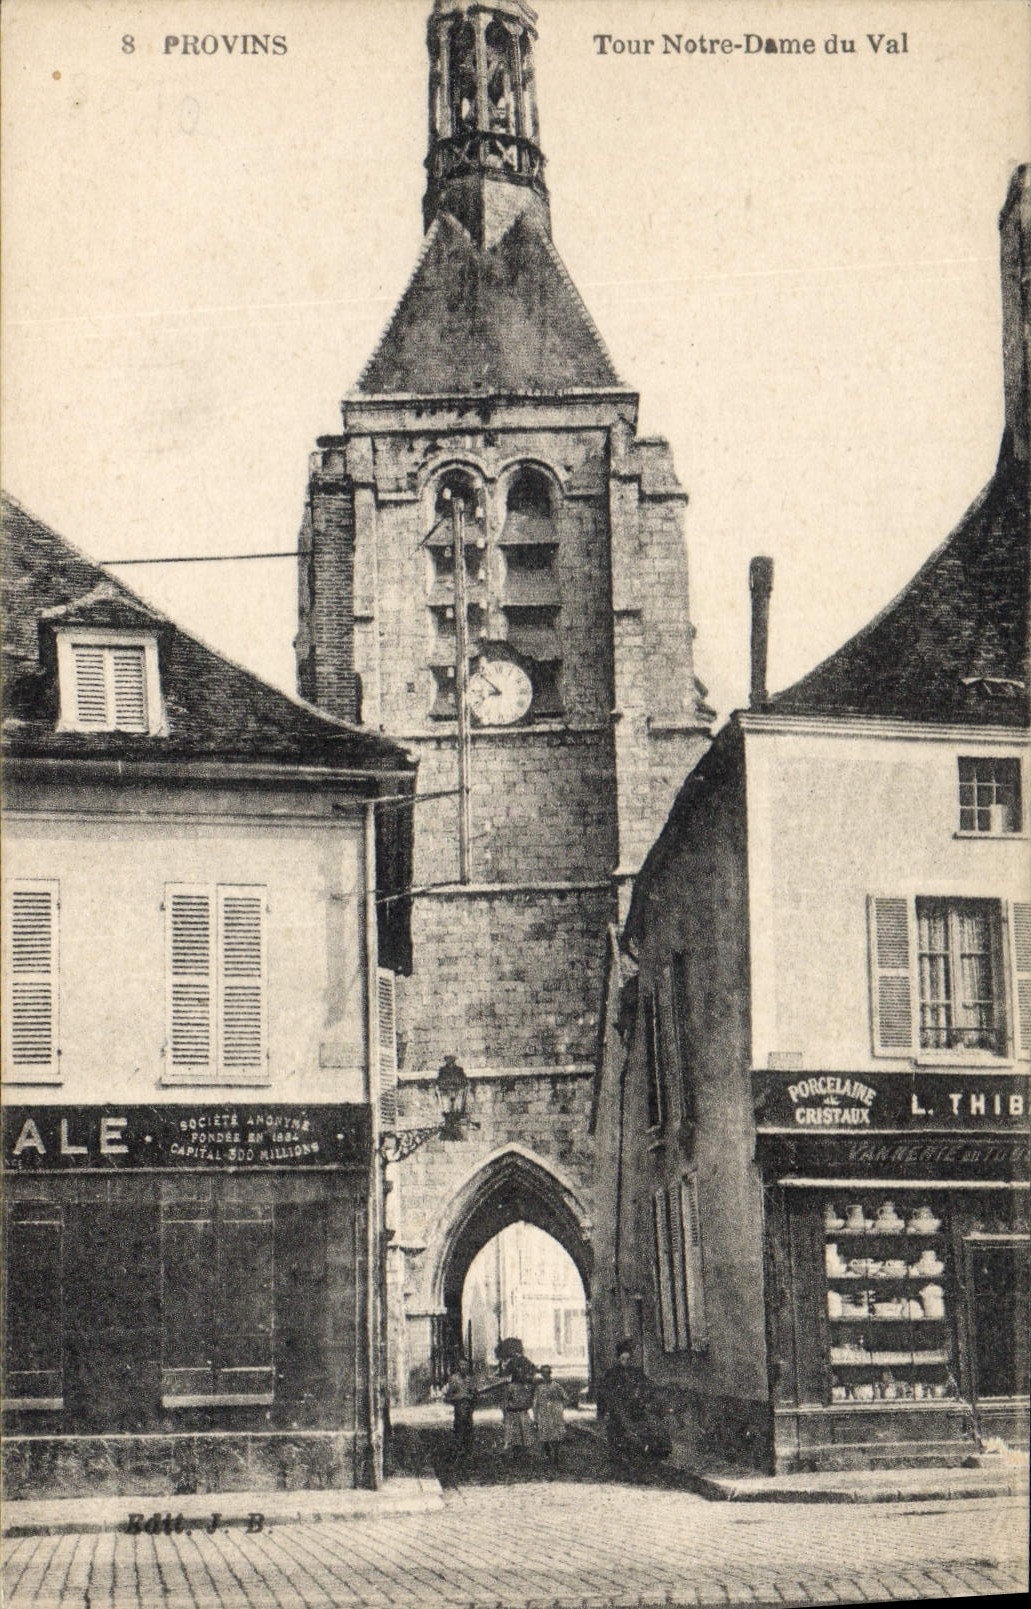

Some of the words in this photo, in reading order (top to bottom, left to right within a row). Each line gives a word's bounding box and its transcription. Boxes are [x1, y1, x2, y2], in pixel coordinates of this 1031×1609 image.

[787, 1076, 877, 1107] PORCELAINE
[795, 1107, 870, 1125] CRISTAUX
[12, 1117, 130, 1156] ALE
[247, 1132, 264, 1144] EN
[170, 1142, 222, 1161] CAPITAL
[259, 1141, 320, 1162] MILLIONS
